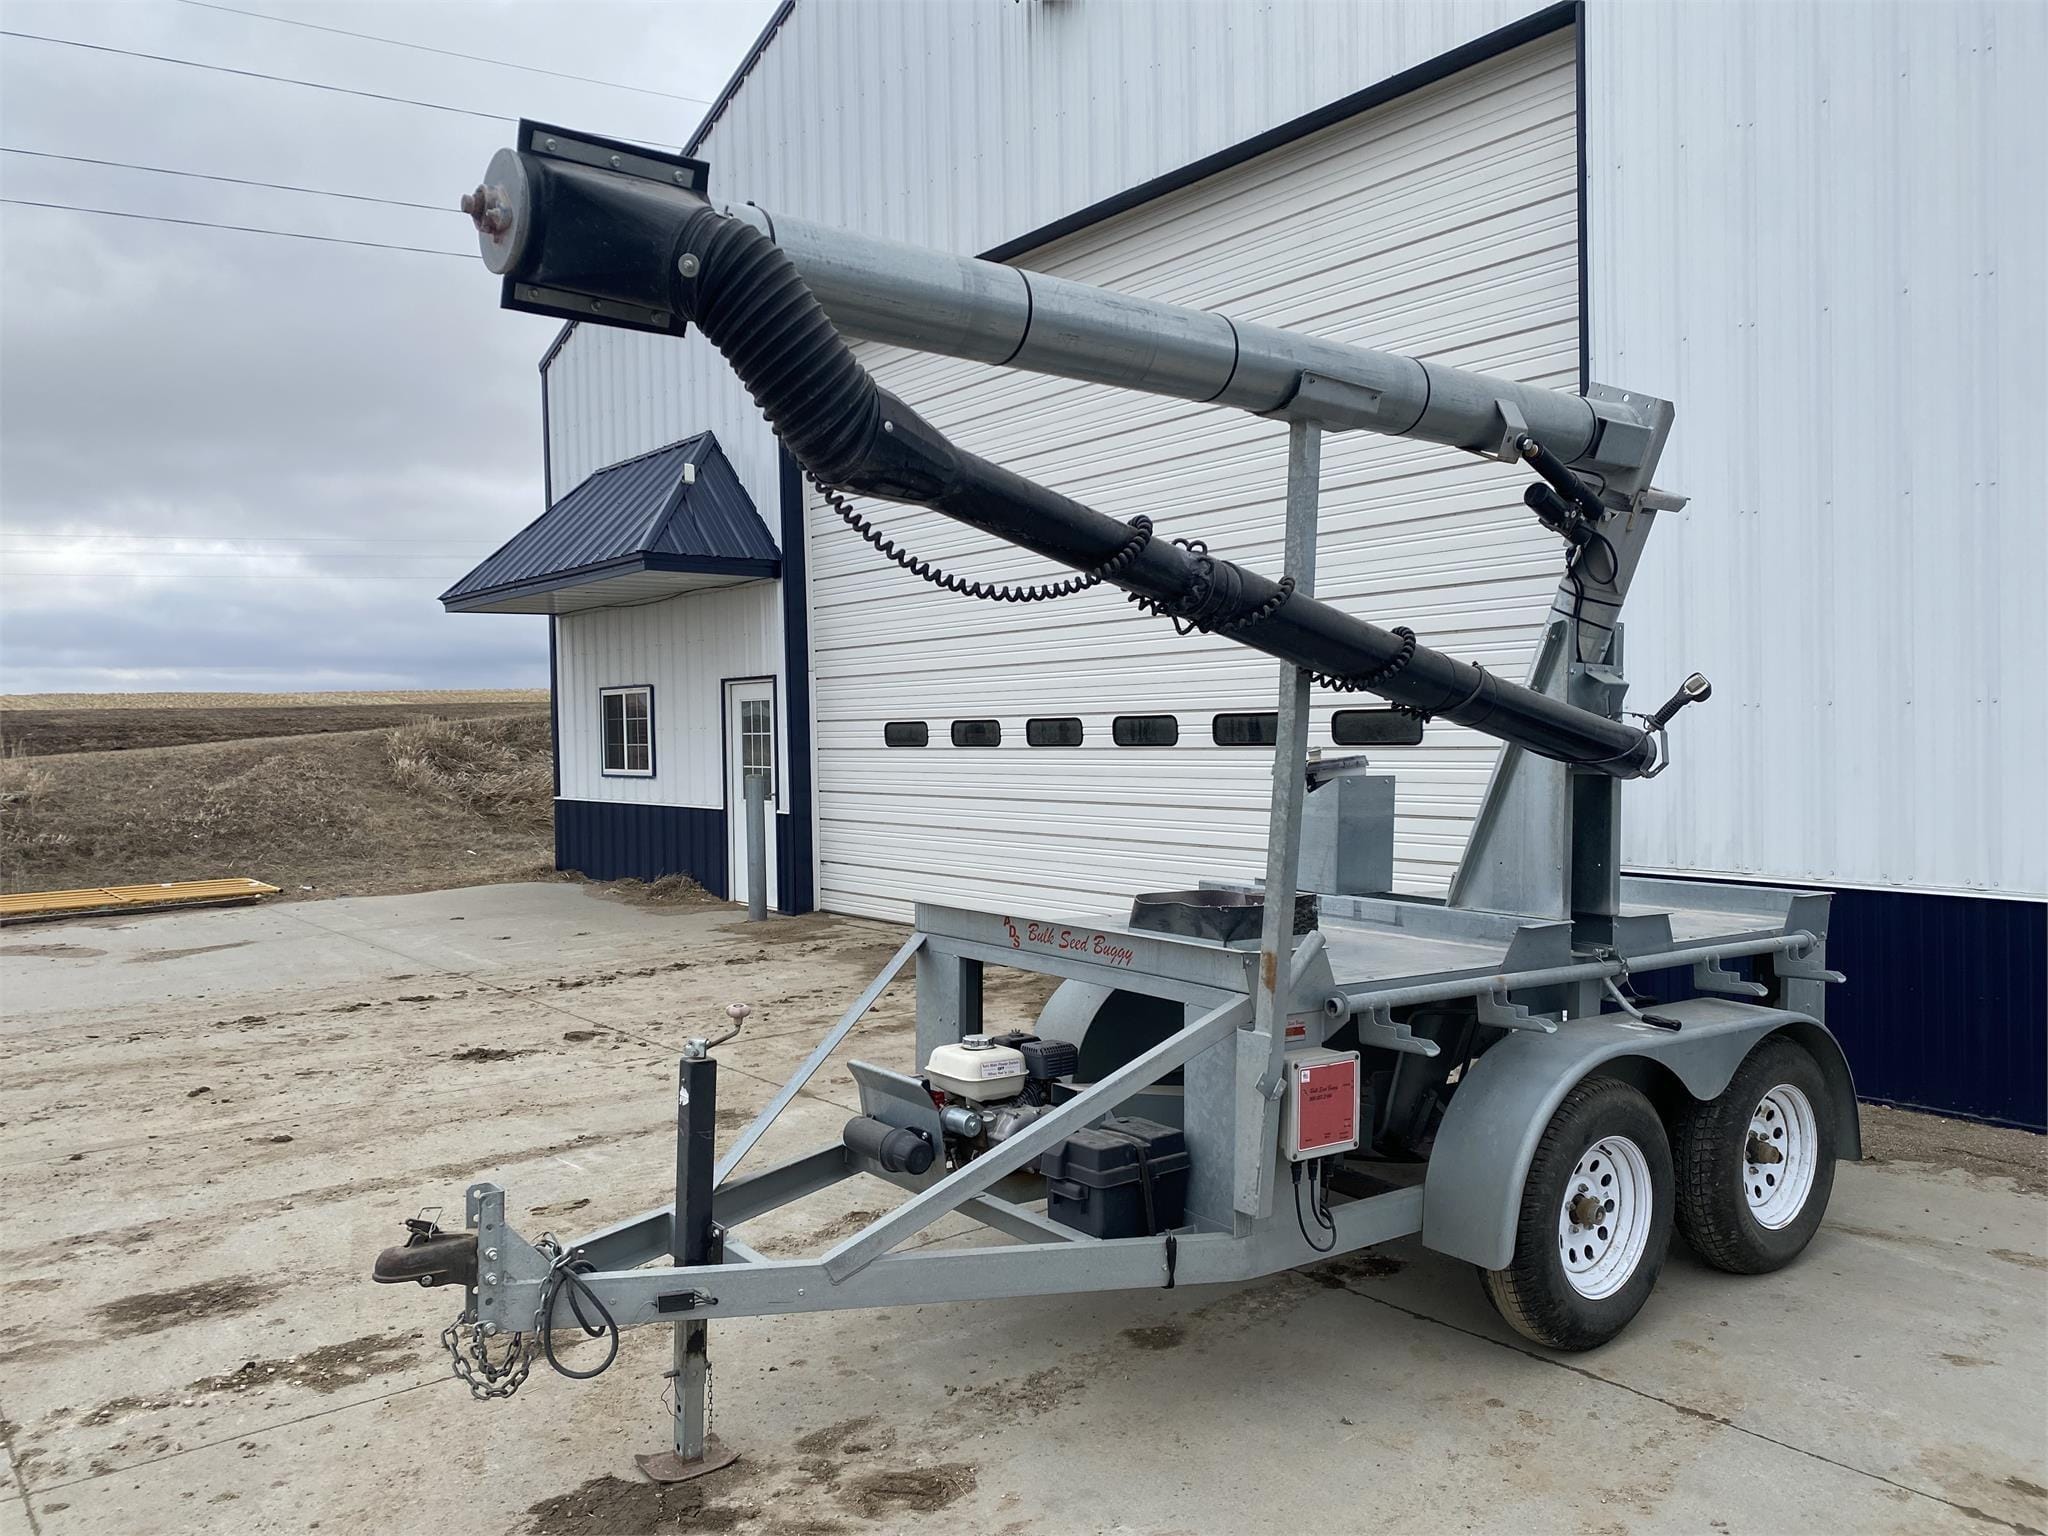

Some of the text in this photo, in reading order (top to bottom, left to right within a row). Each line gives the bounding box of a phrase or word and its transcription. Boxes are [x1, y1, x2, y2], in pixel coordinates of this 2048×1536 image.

[1028, 923, 1134, 966] Bulk Seed Buggy
